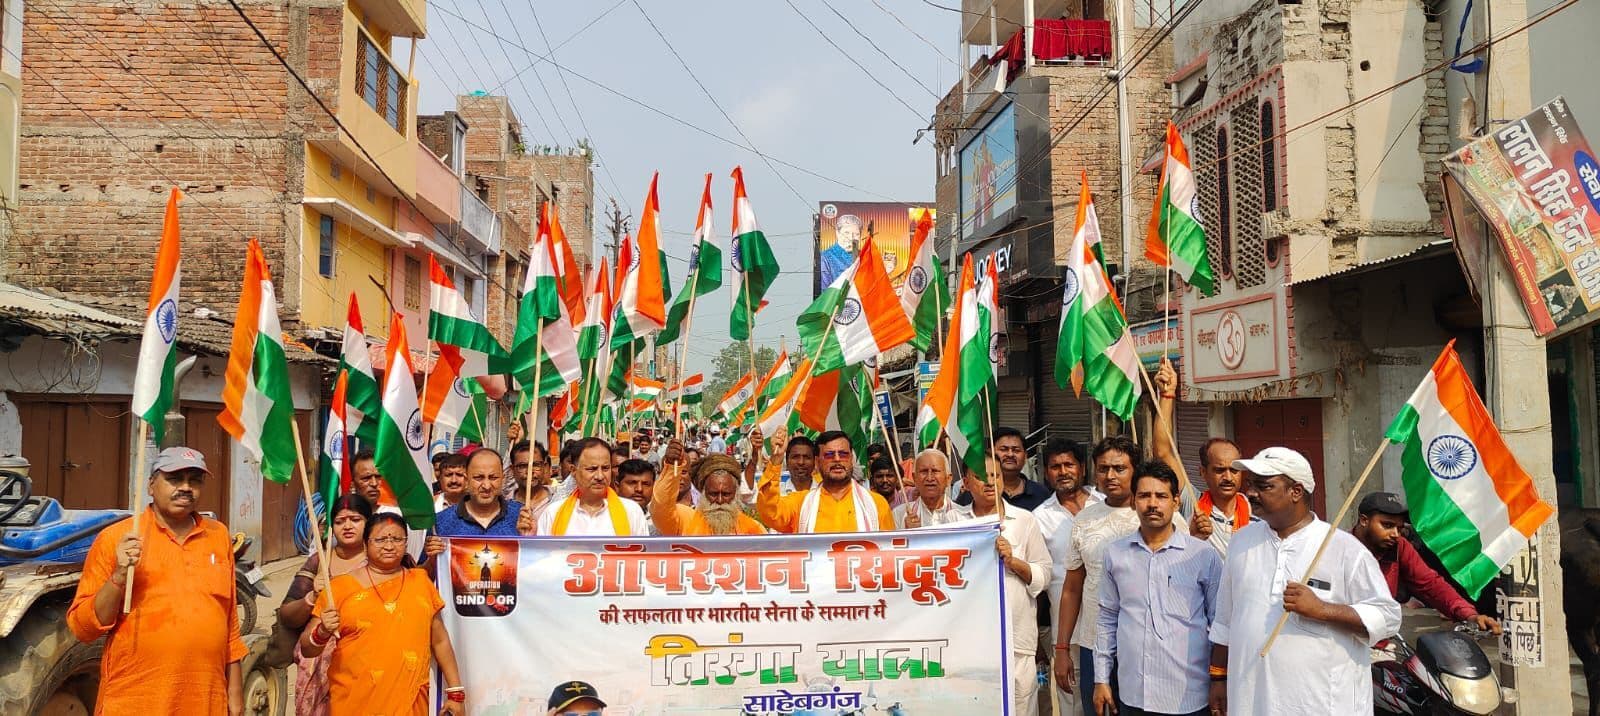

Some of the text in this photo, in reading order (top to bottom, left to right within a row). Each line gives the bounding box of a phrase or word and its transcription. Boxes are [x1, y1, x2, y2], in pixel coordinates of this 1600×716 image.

[1498, 118, 1553, 180] ललन
[1529, 168, 1579, 217] सिंह
[1552, 204, 1594, 254] टेन्ट
[469, 580, 501, 589] OPERATION
[563, 538, 972, 605] ऑपरेशन सिंदूर
[456, 594, 514, 606] SINDOOR
[599, 599, 887, 625] की सफलता पर भारतीय सेना के सम्मान में
[644, 632, 948, 686] तिरंगा यात्रा
[743, 686, 862, 714] साहेबगंज
